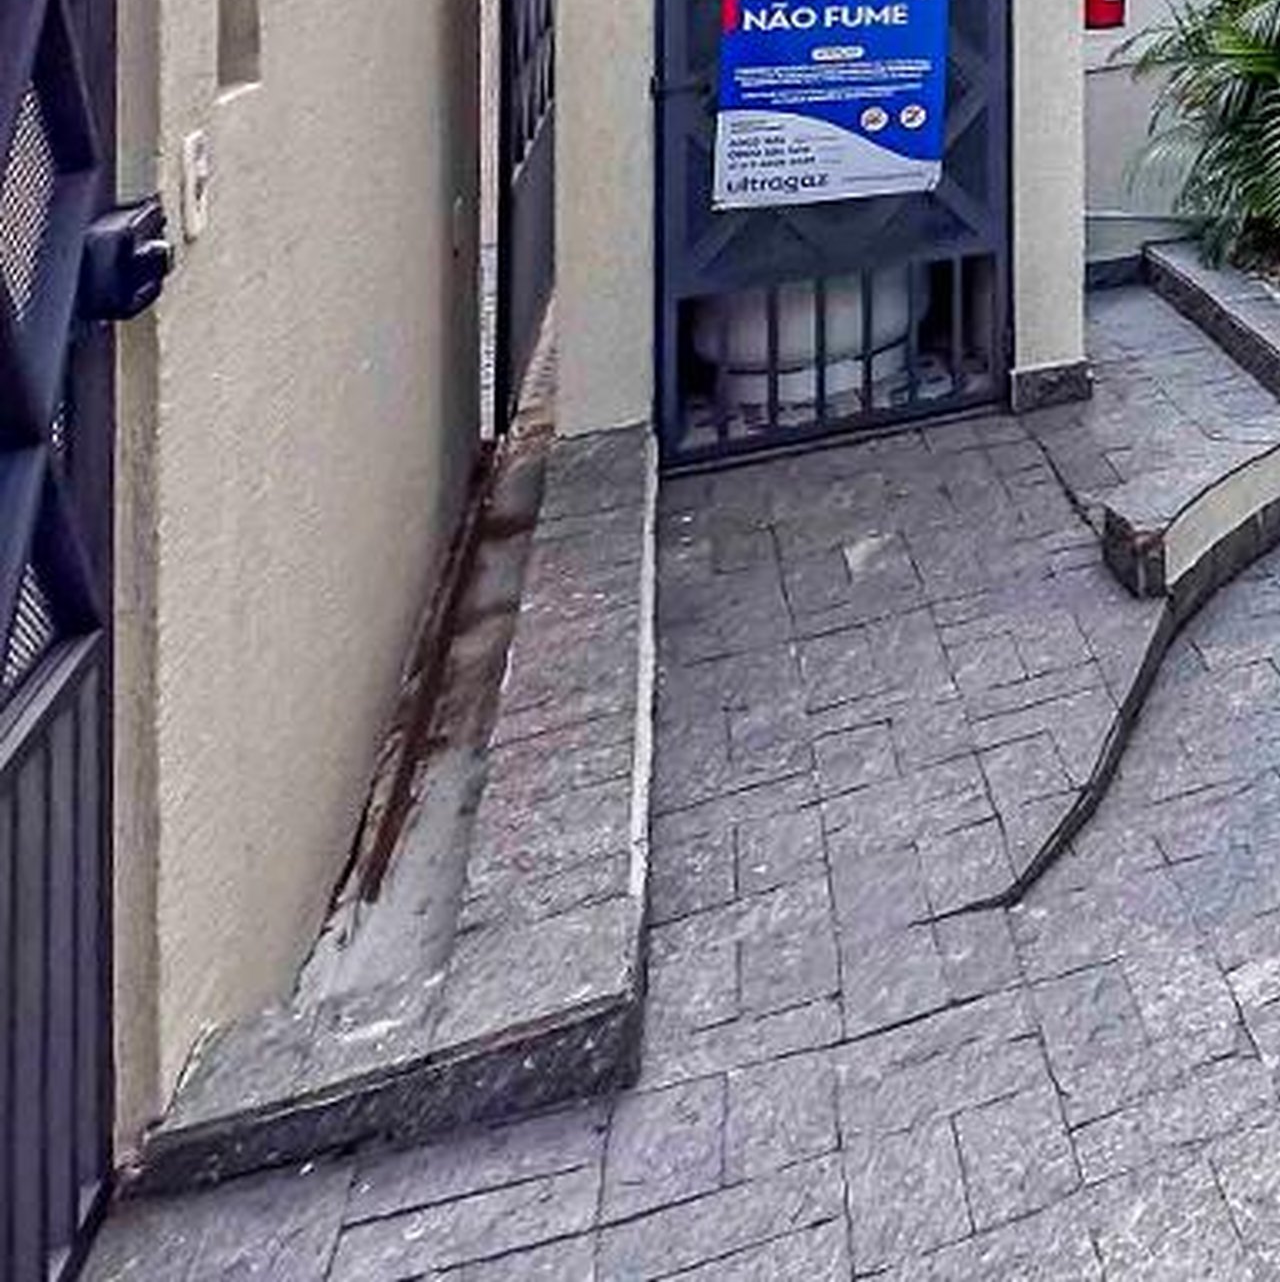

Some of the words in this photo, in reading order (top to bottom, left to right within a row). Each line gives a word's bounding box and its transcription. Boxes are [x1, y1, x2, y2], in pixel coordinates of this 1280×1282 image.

[742, 3, 817, 31] NÃO
[823, 4, 909, 28] FUME
[727, 173, 829, 195] ultragaz
